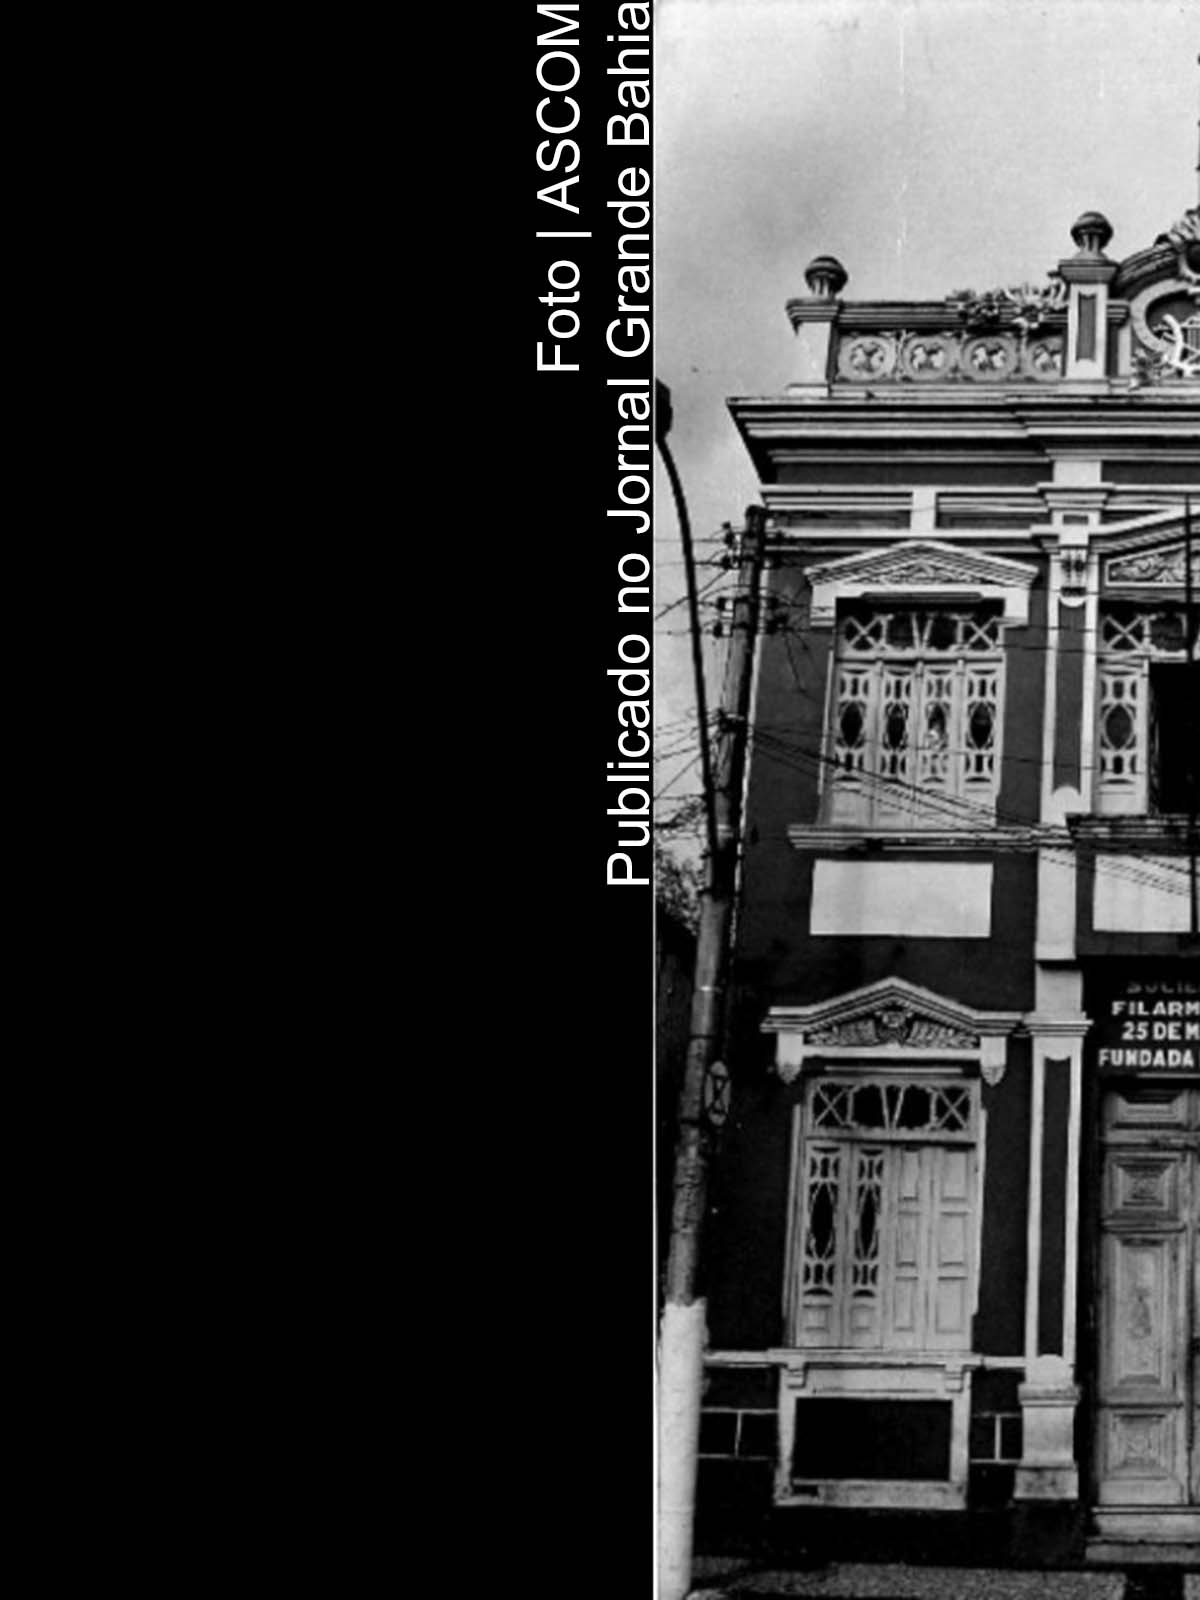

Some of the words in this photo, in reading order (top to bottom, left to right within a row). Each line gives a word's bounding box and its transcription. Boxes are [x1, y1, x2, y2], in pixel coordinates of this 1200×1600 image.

[1121, 1020, 1149, 1041] 25
[1152, 1021, 1182, 1041] DE
[1098, 1048, 1195, 1068] FUNDADA
